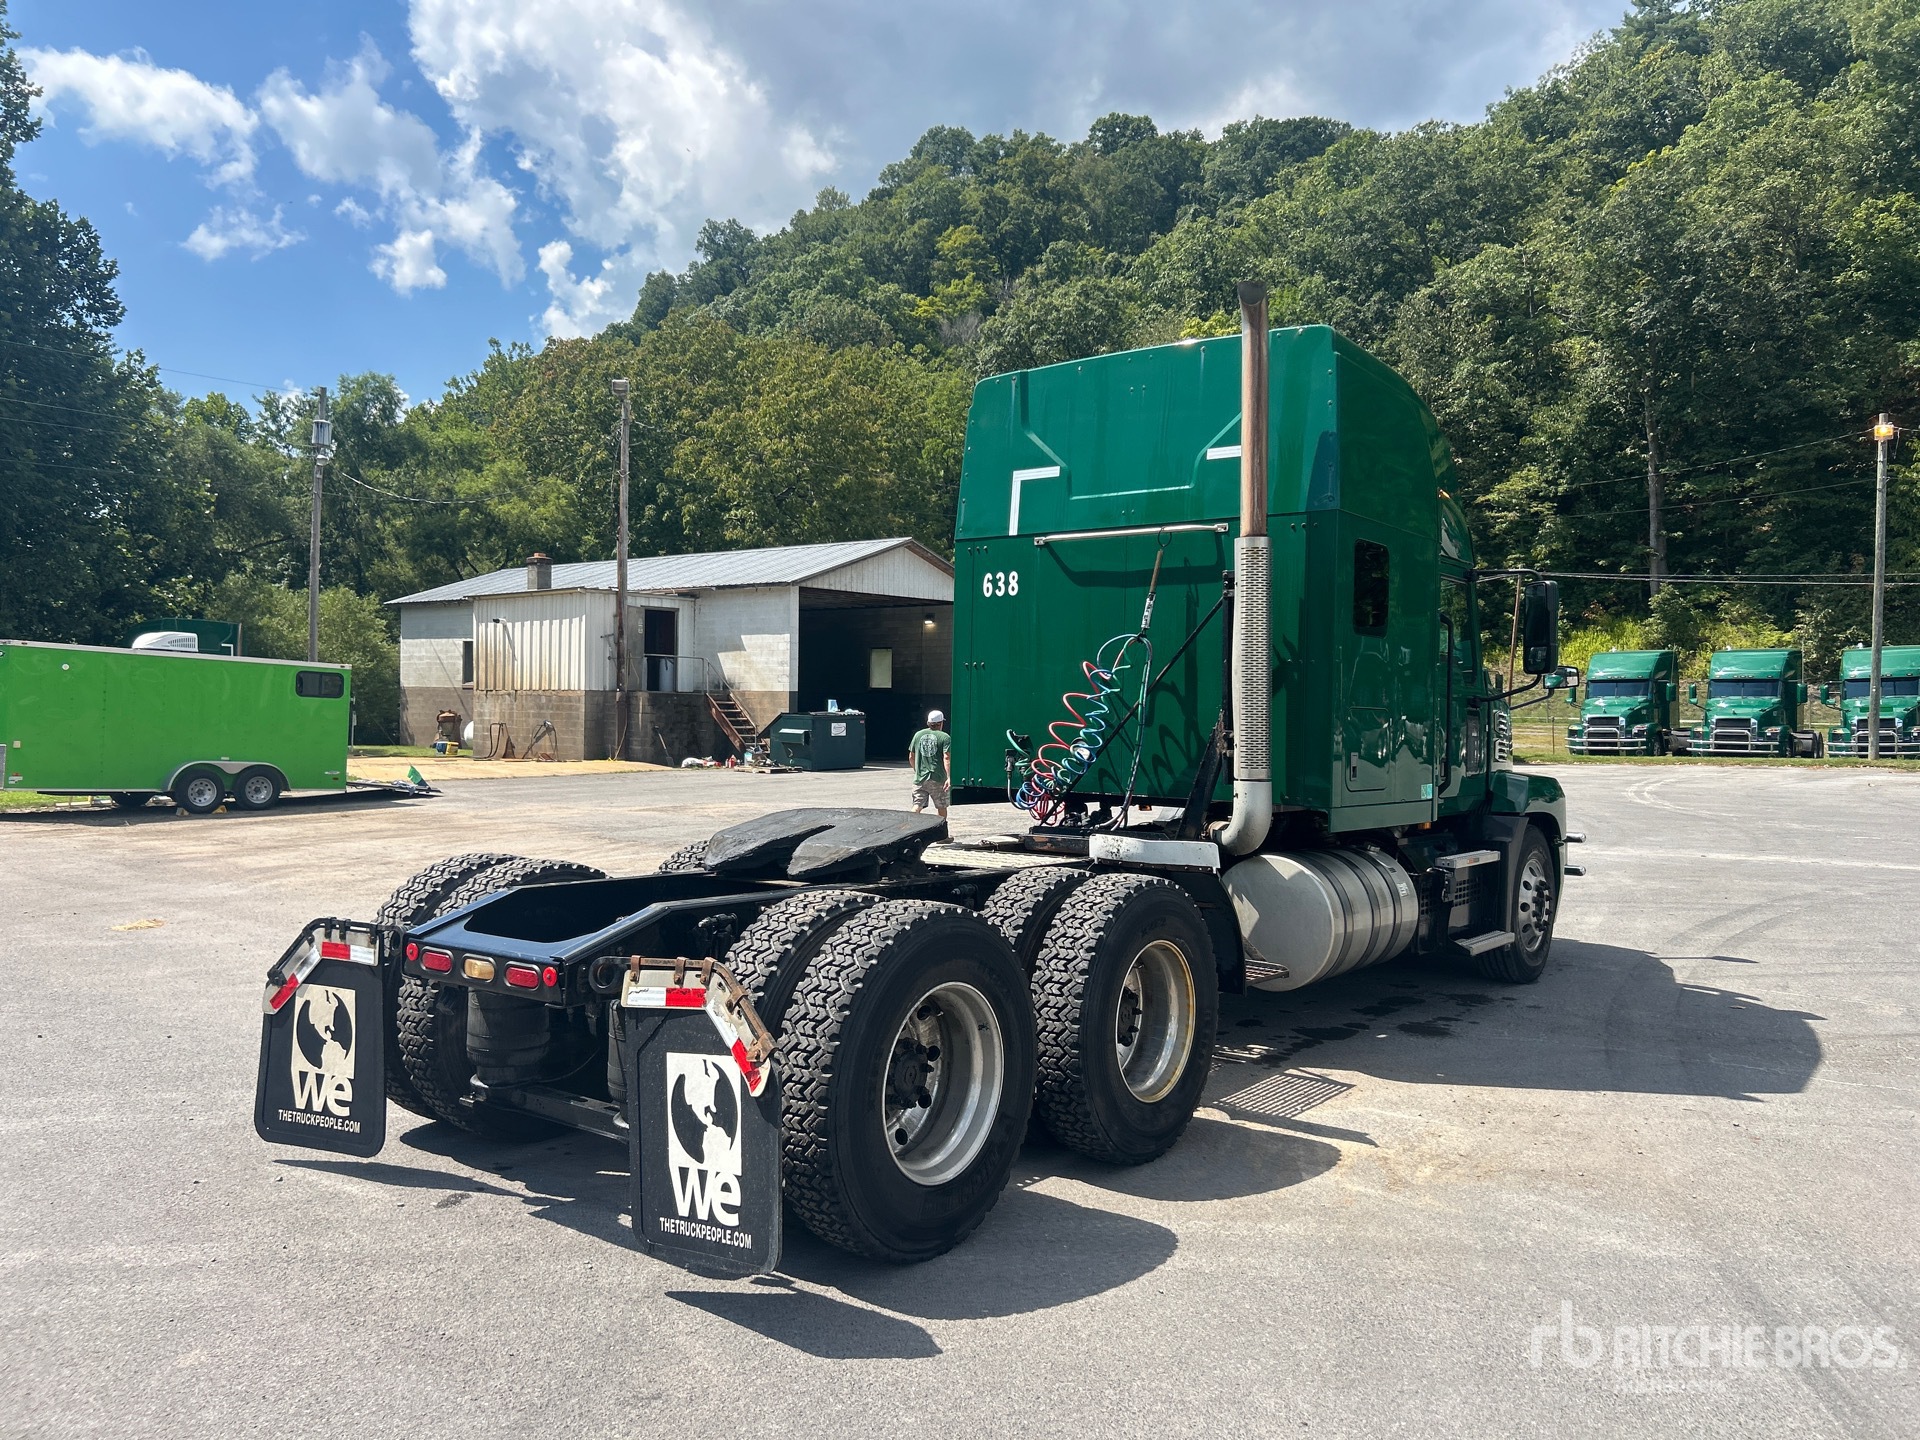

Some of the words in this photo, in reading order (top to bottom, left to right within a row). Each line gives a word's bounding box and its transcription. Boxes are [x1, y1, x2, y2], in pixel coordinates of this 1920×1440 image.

[983, 570, 1019, 598] 638
[278, 1109, 361, 1133] THETRUCKPEOPLE.COM
[659, 1216, 752, 1250] THETRUCKPEOPLE.COM
